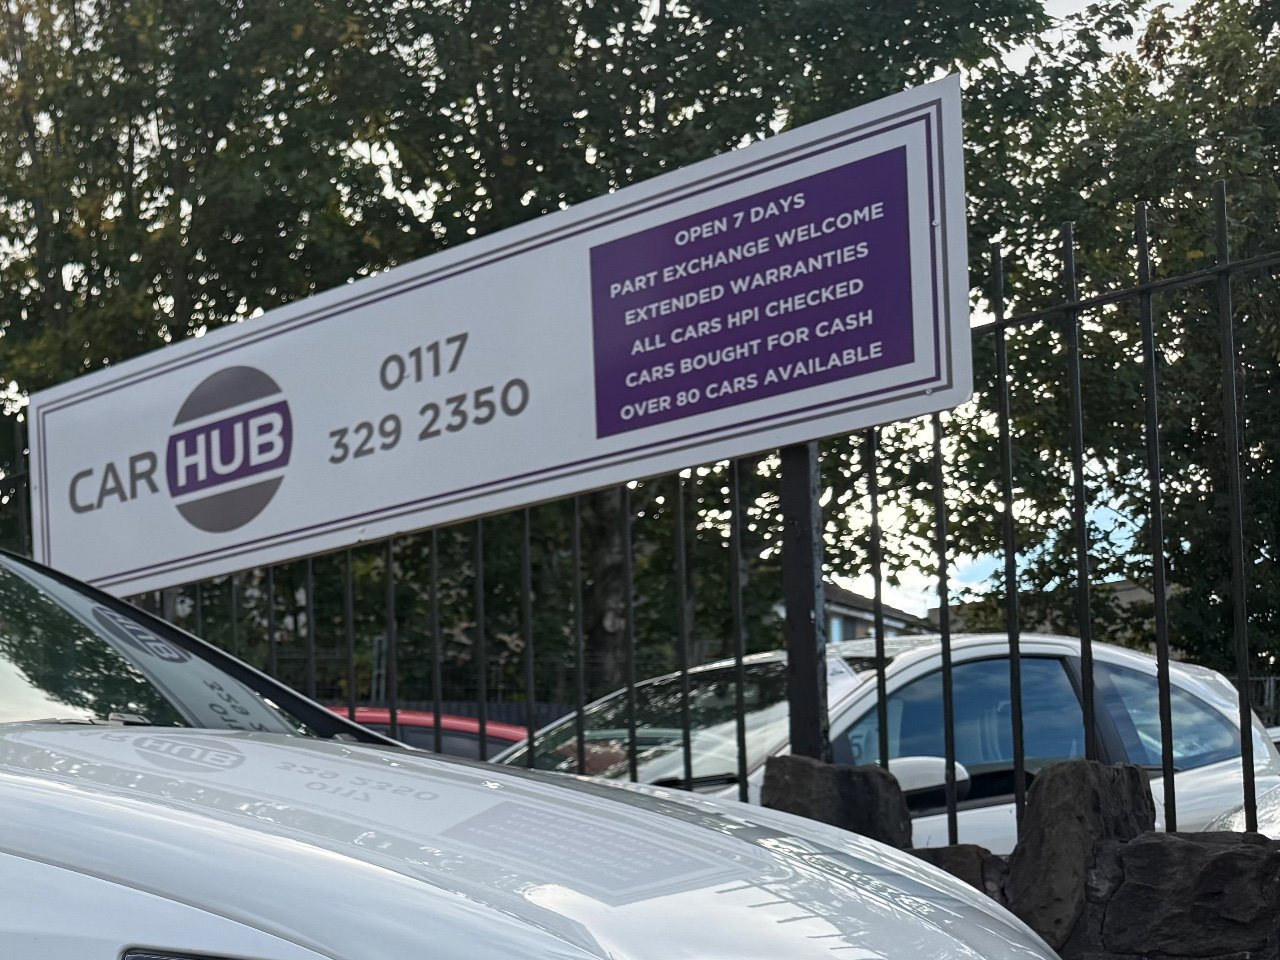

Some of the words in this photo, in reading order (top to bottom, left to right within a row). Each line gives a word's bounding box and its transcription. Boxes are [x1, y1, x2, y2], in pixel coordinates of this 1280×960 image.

[610, 271, 658, 298] PART
[663, 240, 770, 283] EXCHANGE
[774, 202, 885, 248] WELCOME
[674, 218, 727, 247] OPEN
[734, 212, 746, 229] 7
[750, 193, 806, 224] DAYS
[624, 284, 725, 326] EXTENDED
[730, 242, 869, 295] WARRANTIES
[631, 334, 666, 356] ALL
[671, 318, 722, 346] CARS
[727, 306, 760, 329] HPI
[765, 278, 864, 318] CHECKED
[379, 333, 469, 391] 0117
[620, 394, 671, 421] OVER
[676, 388, 701, 406] 80
[705, 374, 758, 400] CARS
[763, 341, 883, 386] AVAILABLE
[625, 361, 675, 389] CARS
[680, 339, 761, 375] BOUGHT
[767, 326, 810, 355] FOR
[815, 309, 874, 344] CASH
[328, 414, 402, 465] 329
[418, 378, 530, 441] 2350
[69, 451, 160, 514] CAR
[175, 411, 285, 488] HUB
